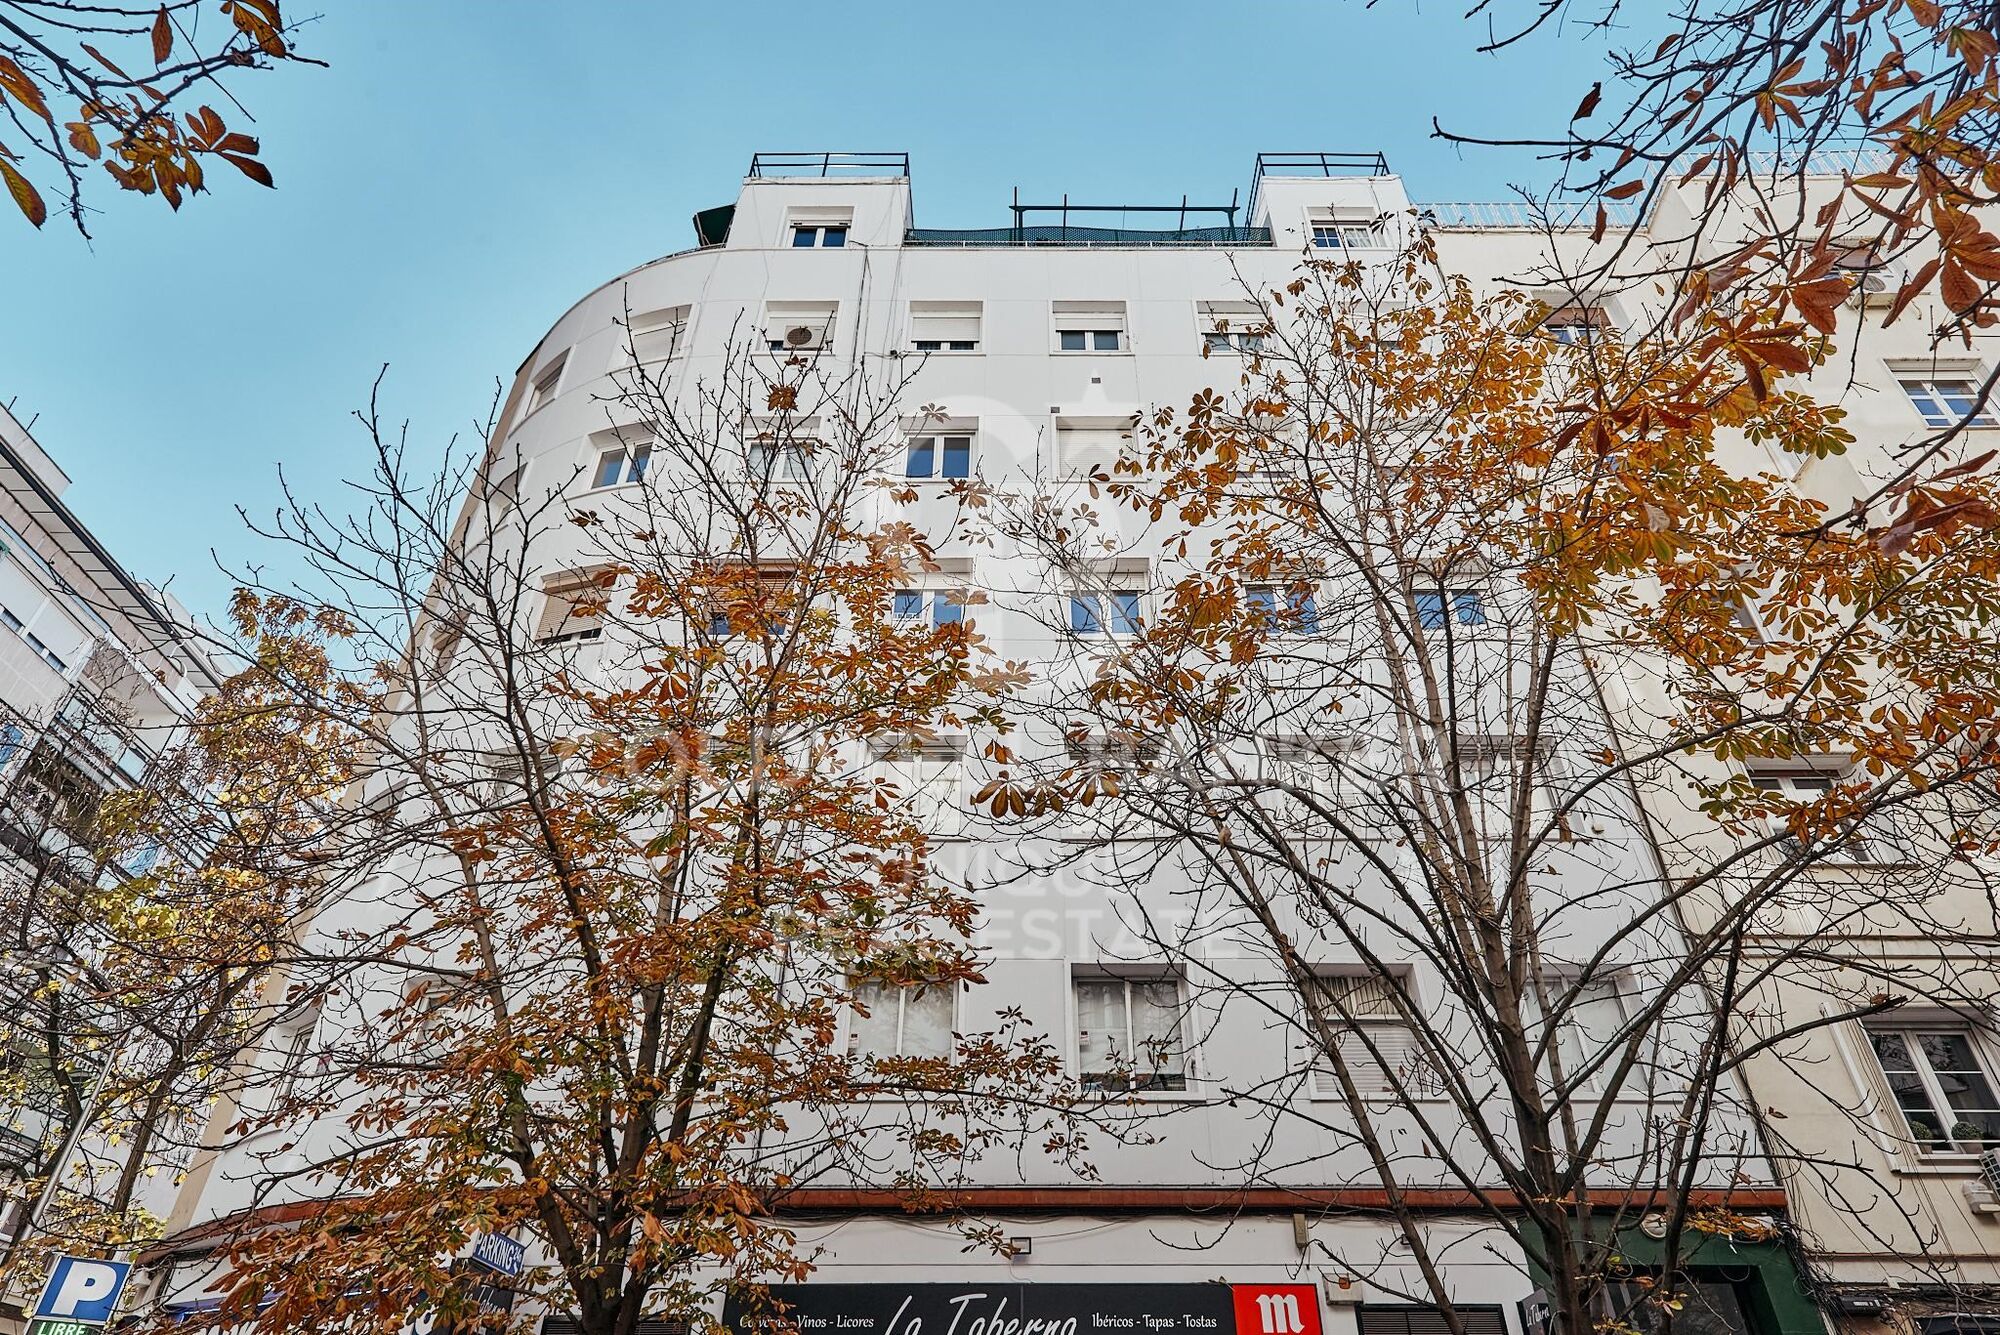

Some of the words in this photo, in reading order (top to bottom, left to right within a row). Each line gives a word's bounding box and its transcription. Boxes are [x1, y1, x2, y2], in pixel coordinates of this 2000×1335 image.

[474, 1231, 515, 1271] PARKING
[49, 1261, 117, 1315] P
[797, 1313, 827, 1329] Vinos
[836, 1313, 875, 1328] Licores
[947, 1293, 1077, 1335] Taberna
[1092, 1312, 1134, 1328] Ibéricos
[1142, 1313, 1175, 1332] Tapas
[1183, 1313, 1218, 1328] Tostas
